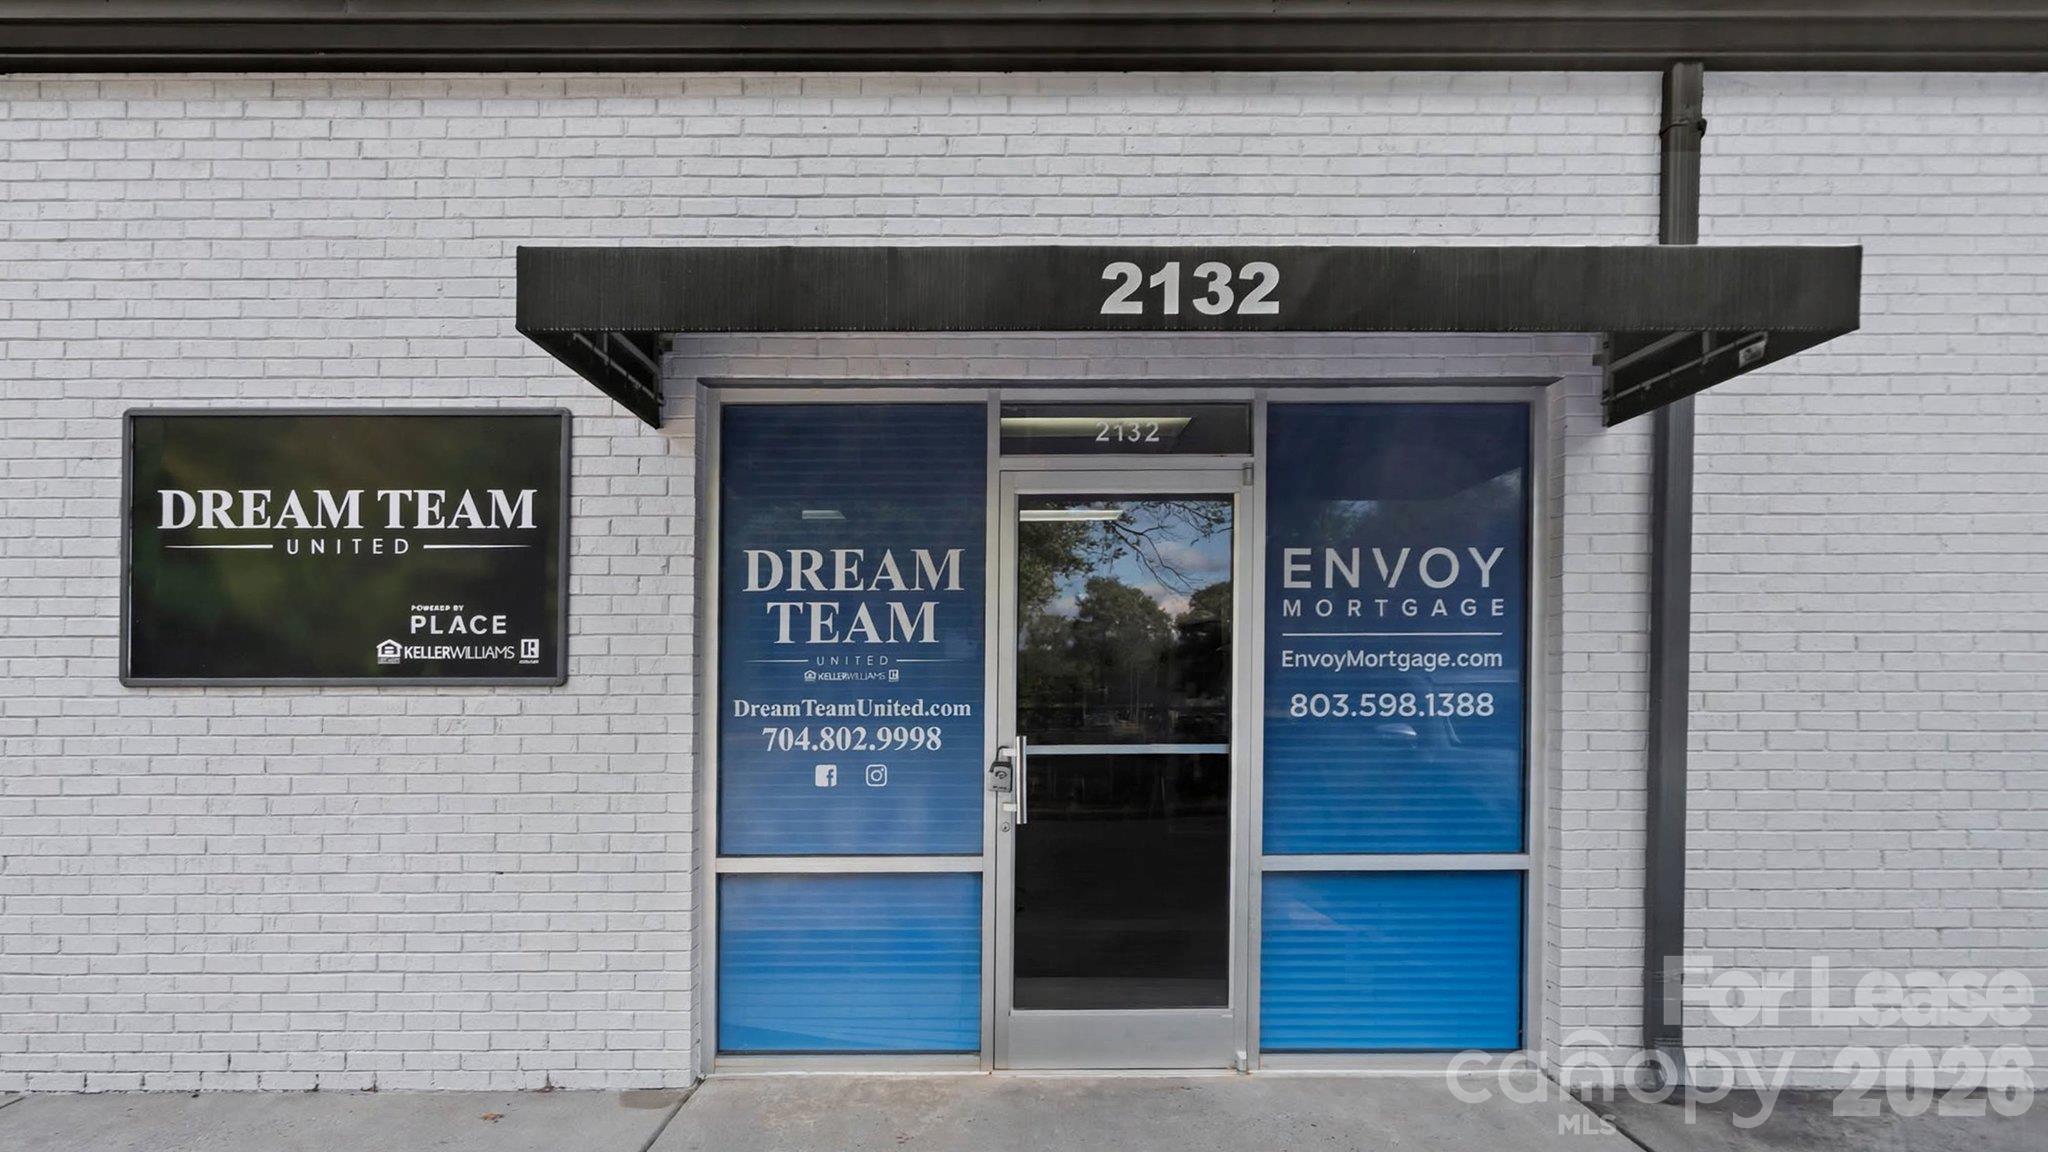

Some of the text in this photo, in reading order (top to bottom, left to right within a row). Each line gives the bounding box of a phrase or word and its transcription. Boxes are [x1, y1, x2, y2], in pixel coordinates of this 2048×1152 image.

[1100, 261, 1280, 316] 2132
[1095, 421, 1160, 443] 2132
[157, 489, 538, 530] DREAM TEAM
[286, 538, 409, 555] UNITED
[742, 548, 965, 592] DREAM
[1283, 547, 1505, 589] ENVOY
[1283, 598, 1505, 617] MORTGAGE
[410, 615, 507, 635] PLACE
[766, 601, 940, 644] TEAM
[816, 655, 889, 666] UNITED
[1282, 650, 1503, 672] EnvoyMortgage.com
[733, 698, 971, 718] DreamTeamUnited.com
[1290, 692, 1495, 718] 803.598.1388
[761, 726, 942, 752] 704.802.9998
